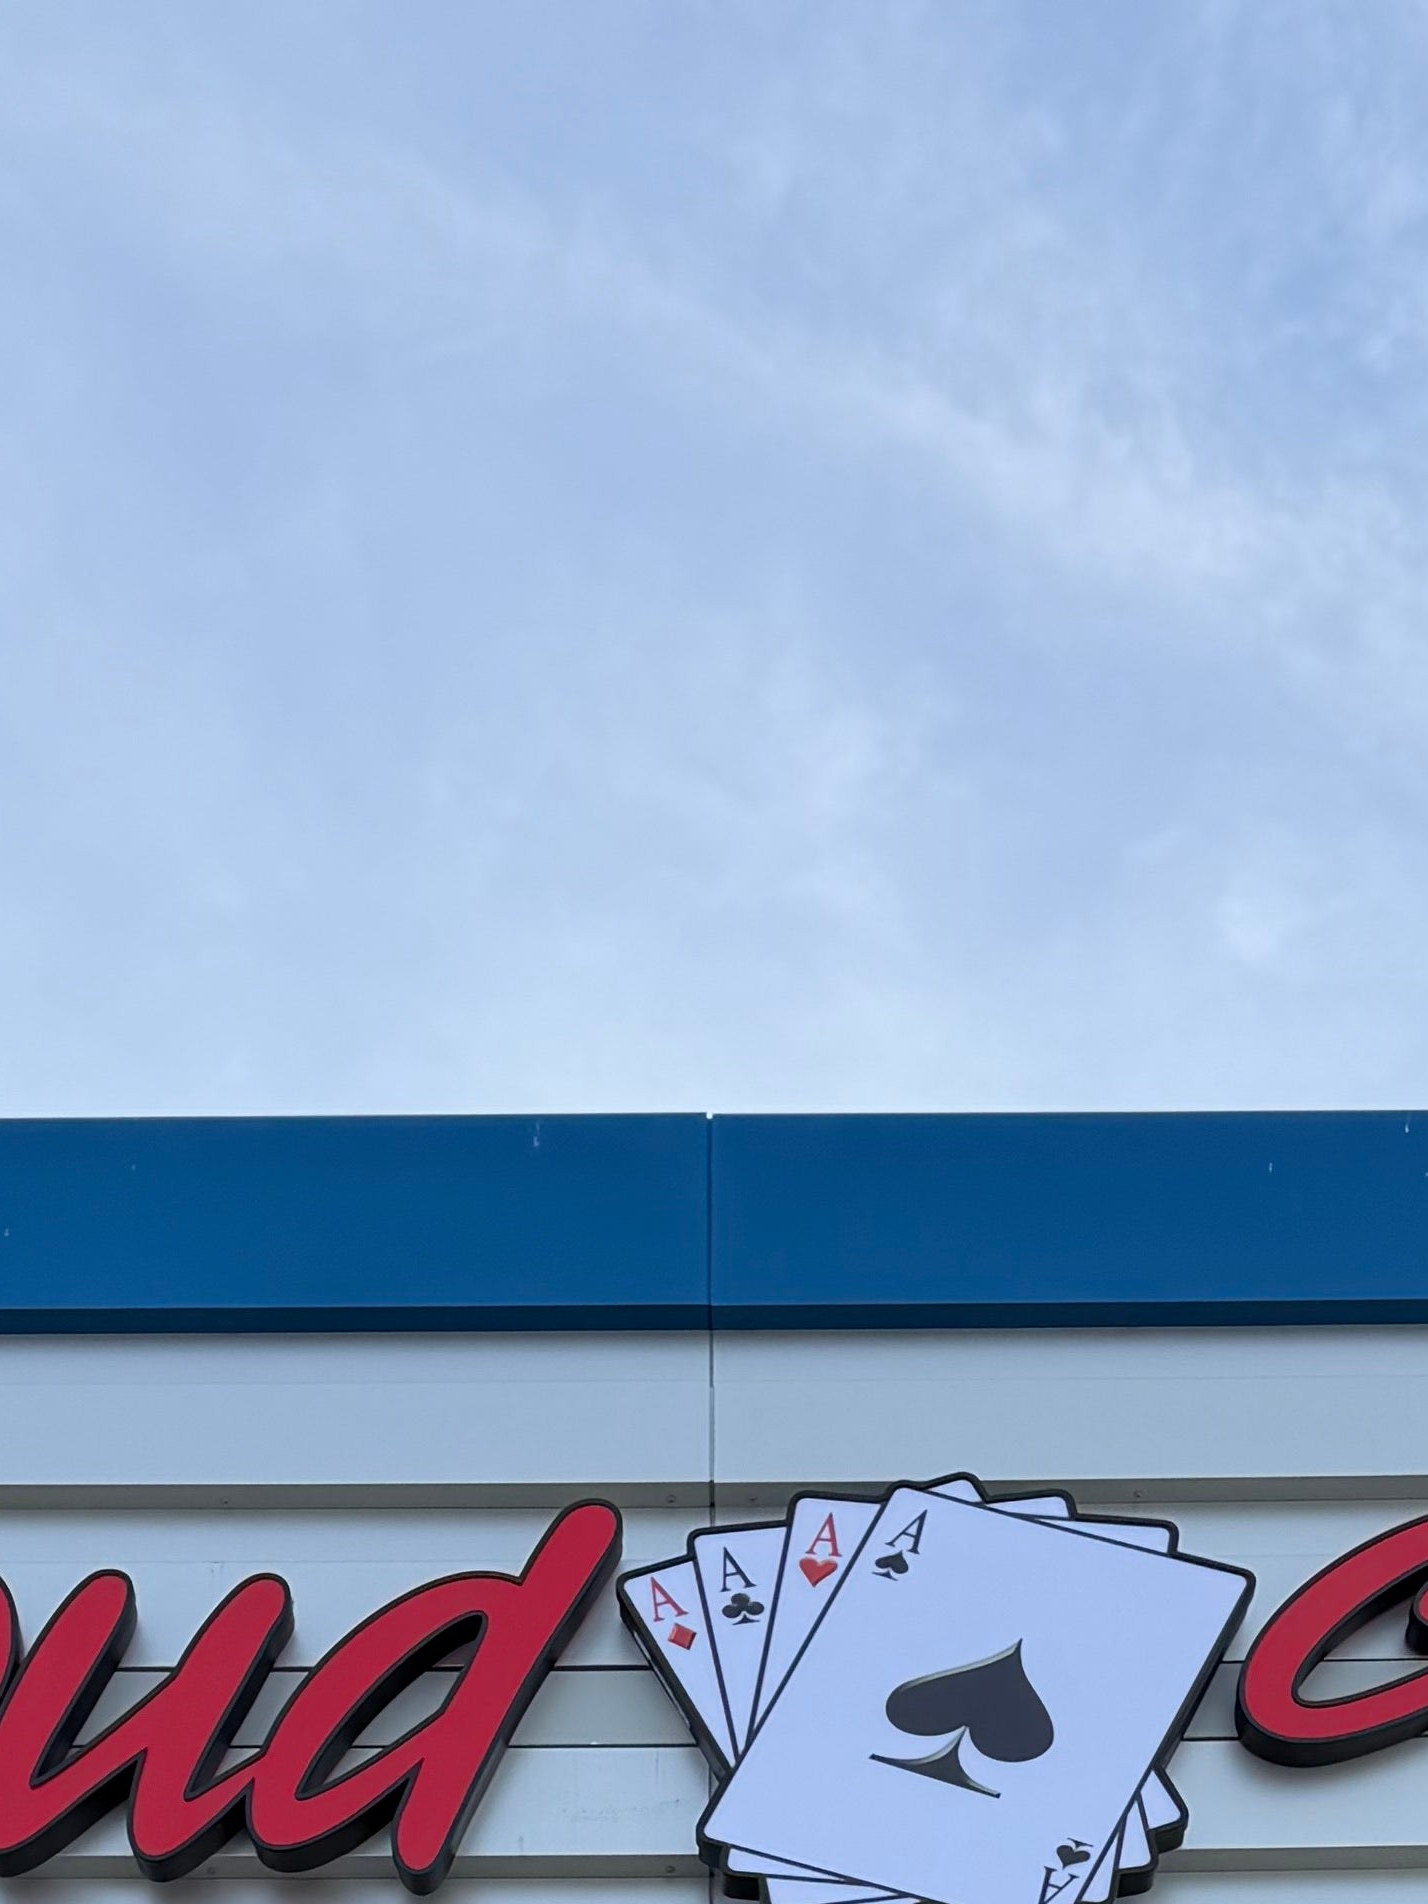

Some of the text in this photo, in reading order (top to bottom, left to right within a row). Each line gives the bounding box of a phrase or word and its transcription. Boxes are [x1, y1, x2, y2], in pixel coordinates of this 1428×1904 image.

[805, 1512, 843, 1557] A
[885, 1509, 928, 1554] A
[720, 1547, 757, 1592] A
[650, 1576, 688, 1622] A
